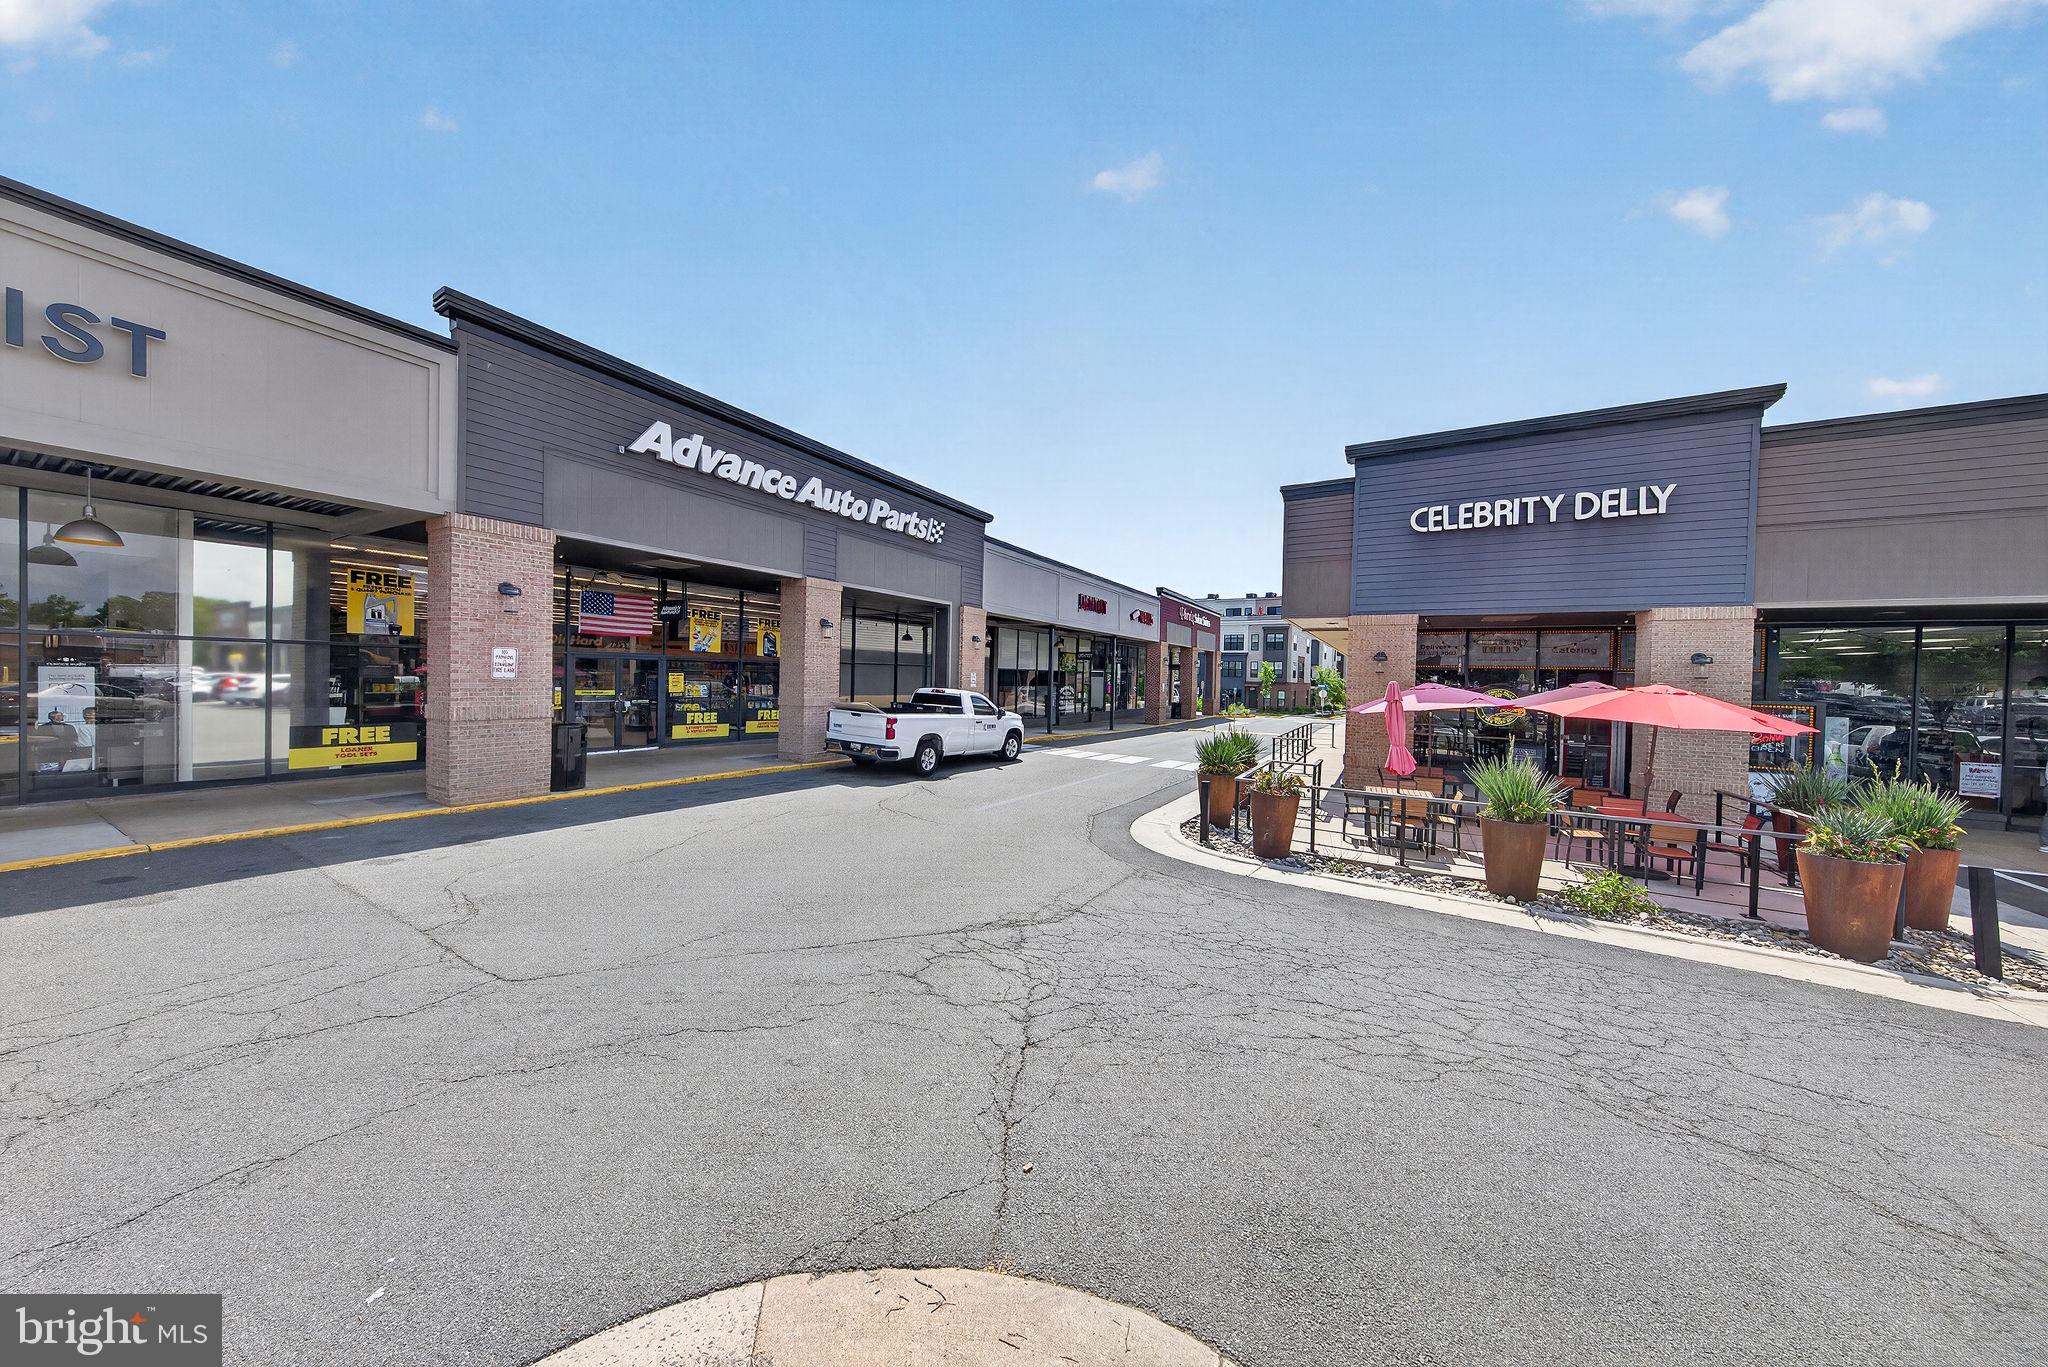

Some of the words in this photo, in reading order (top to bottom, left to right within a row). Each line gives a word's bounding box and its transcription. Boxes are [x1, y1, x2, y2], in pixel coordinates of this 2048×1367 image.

[6, 287, 167, 378] IST
[628, 420, 797, 499] Advance
[796, 476, 868, 521] Auto
[868, 498, 928, 541] Parts
[1410, 494, 1565, 533] CELEBRITY
[1574, 483, 1677, 520] DELLY
[350, 570, 412, 589] FREE
[691, 608, 722, 620] FREE
[758, 617, 780, 628] FREE
[1552, 646, 1598, 655] Catering
[686, 711, 718, 723] FREE
[322, 726, 391, 745] FREE
